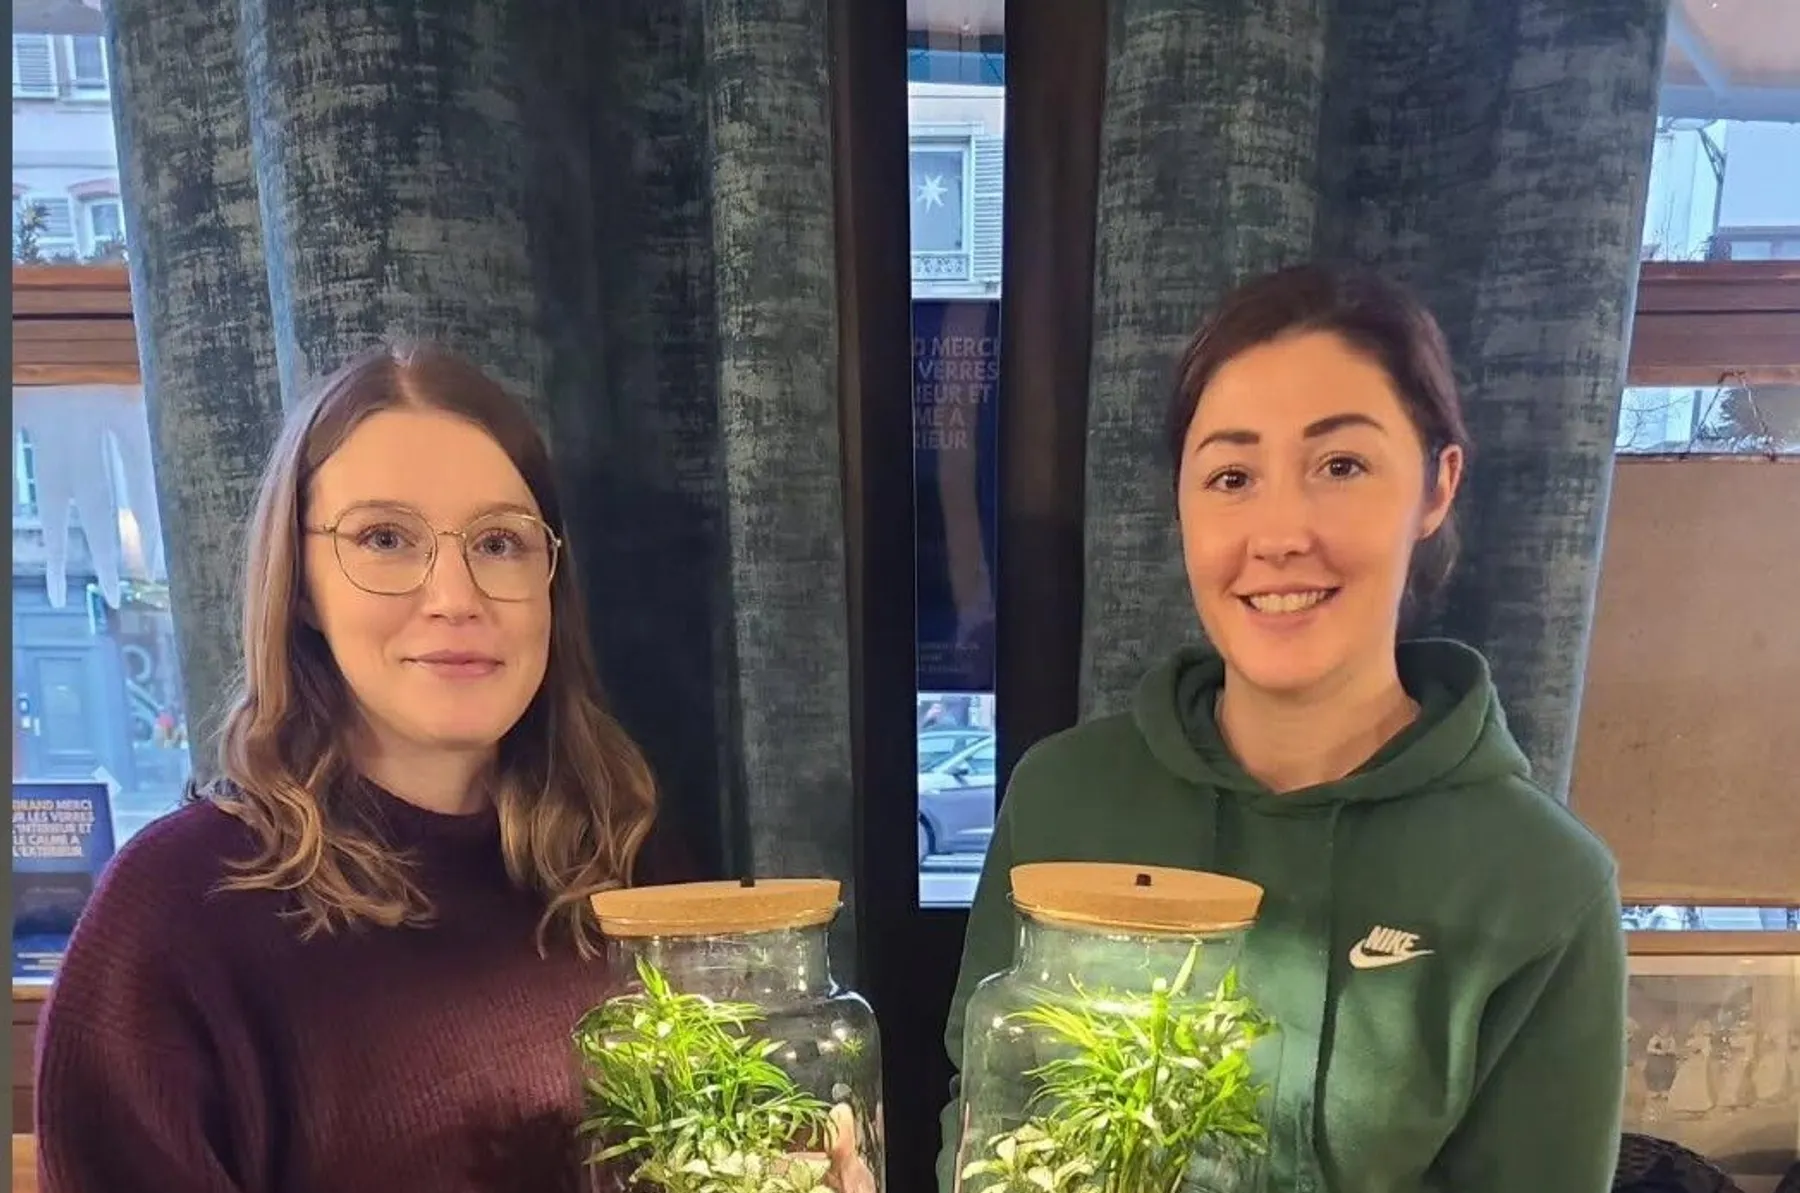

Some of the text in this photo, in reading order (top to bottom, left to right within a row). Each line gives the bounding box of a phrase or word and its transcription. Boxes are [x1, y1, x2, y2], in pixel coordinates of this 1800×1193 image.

[919, 359, 998, 381] VERRES
[969, 383, 992, 404] ET
[1364, 925, 1420, 955] NIKE
